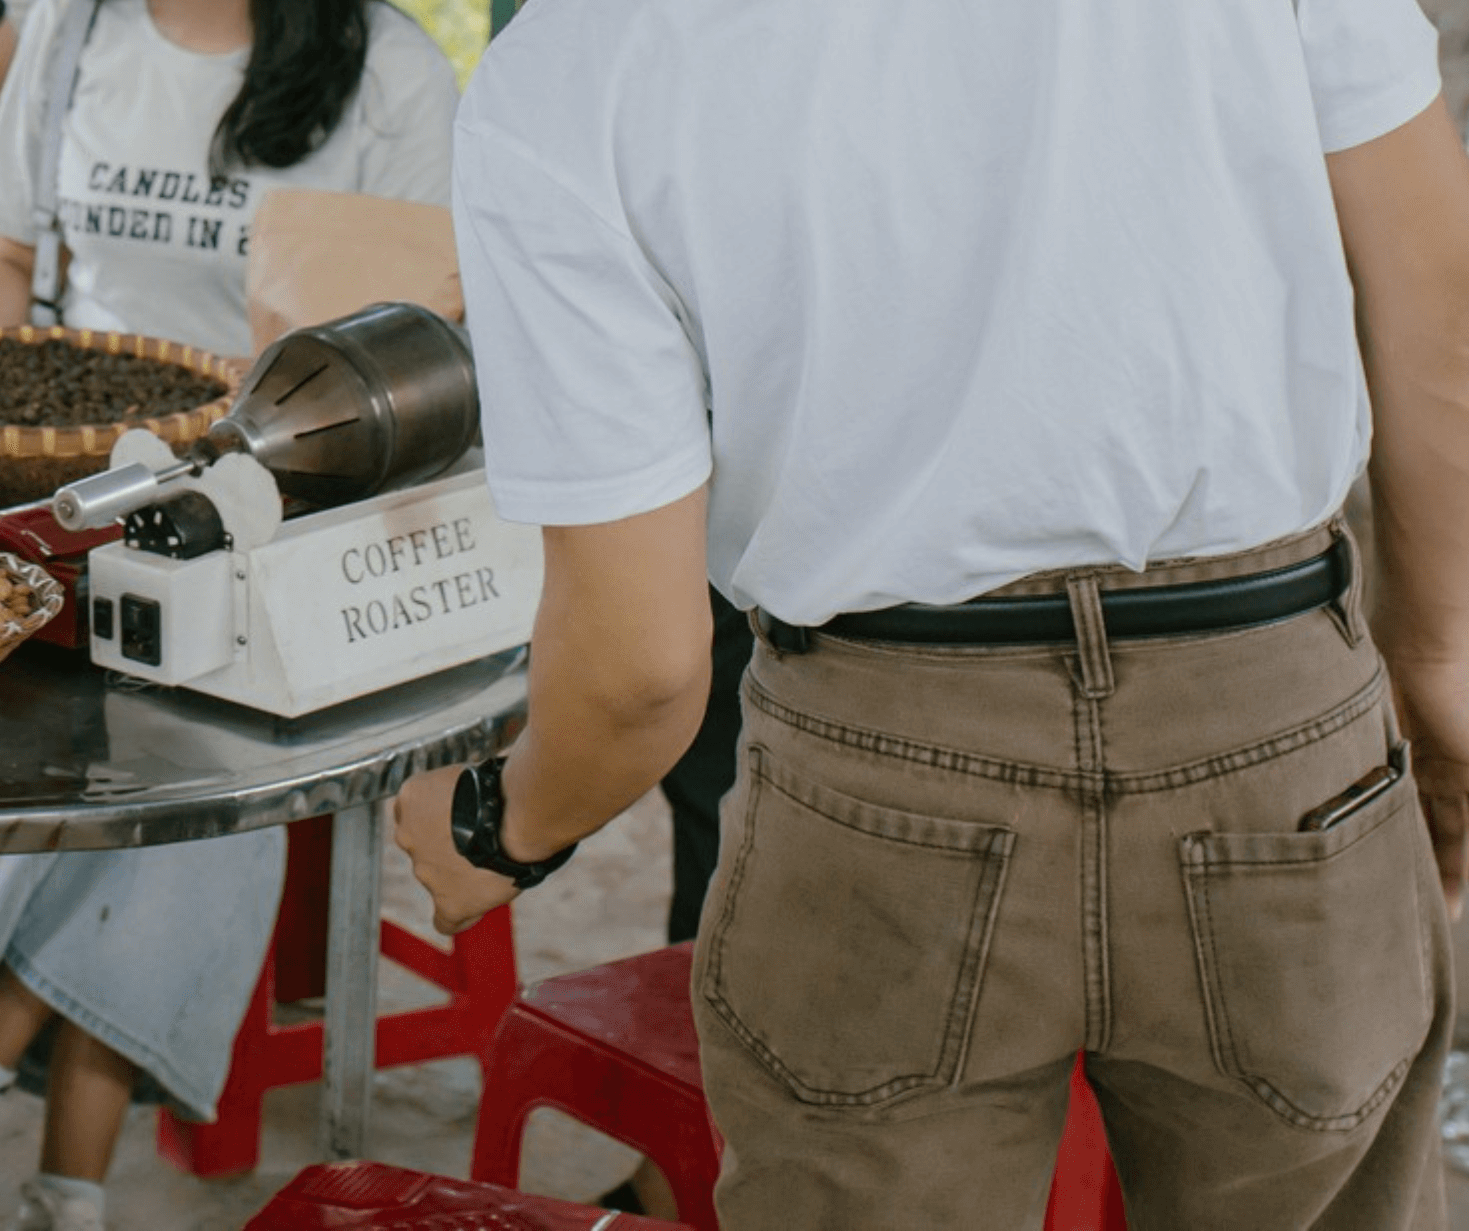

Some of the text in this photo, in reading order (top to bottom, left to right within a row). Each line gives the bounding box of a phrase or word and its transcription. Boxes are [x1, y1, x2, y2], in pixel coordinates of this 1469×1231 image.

[186, 216, 223, 250] IN
[341, 517, 476, 584] COFFEE
[341, 566, 501, 643] ROASTER
